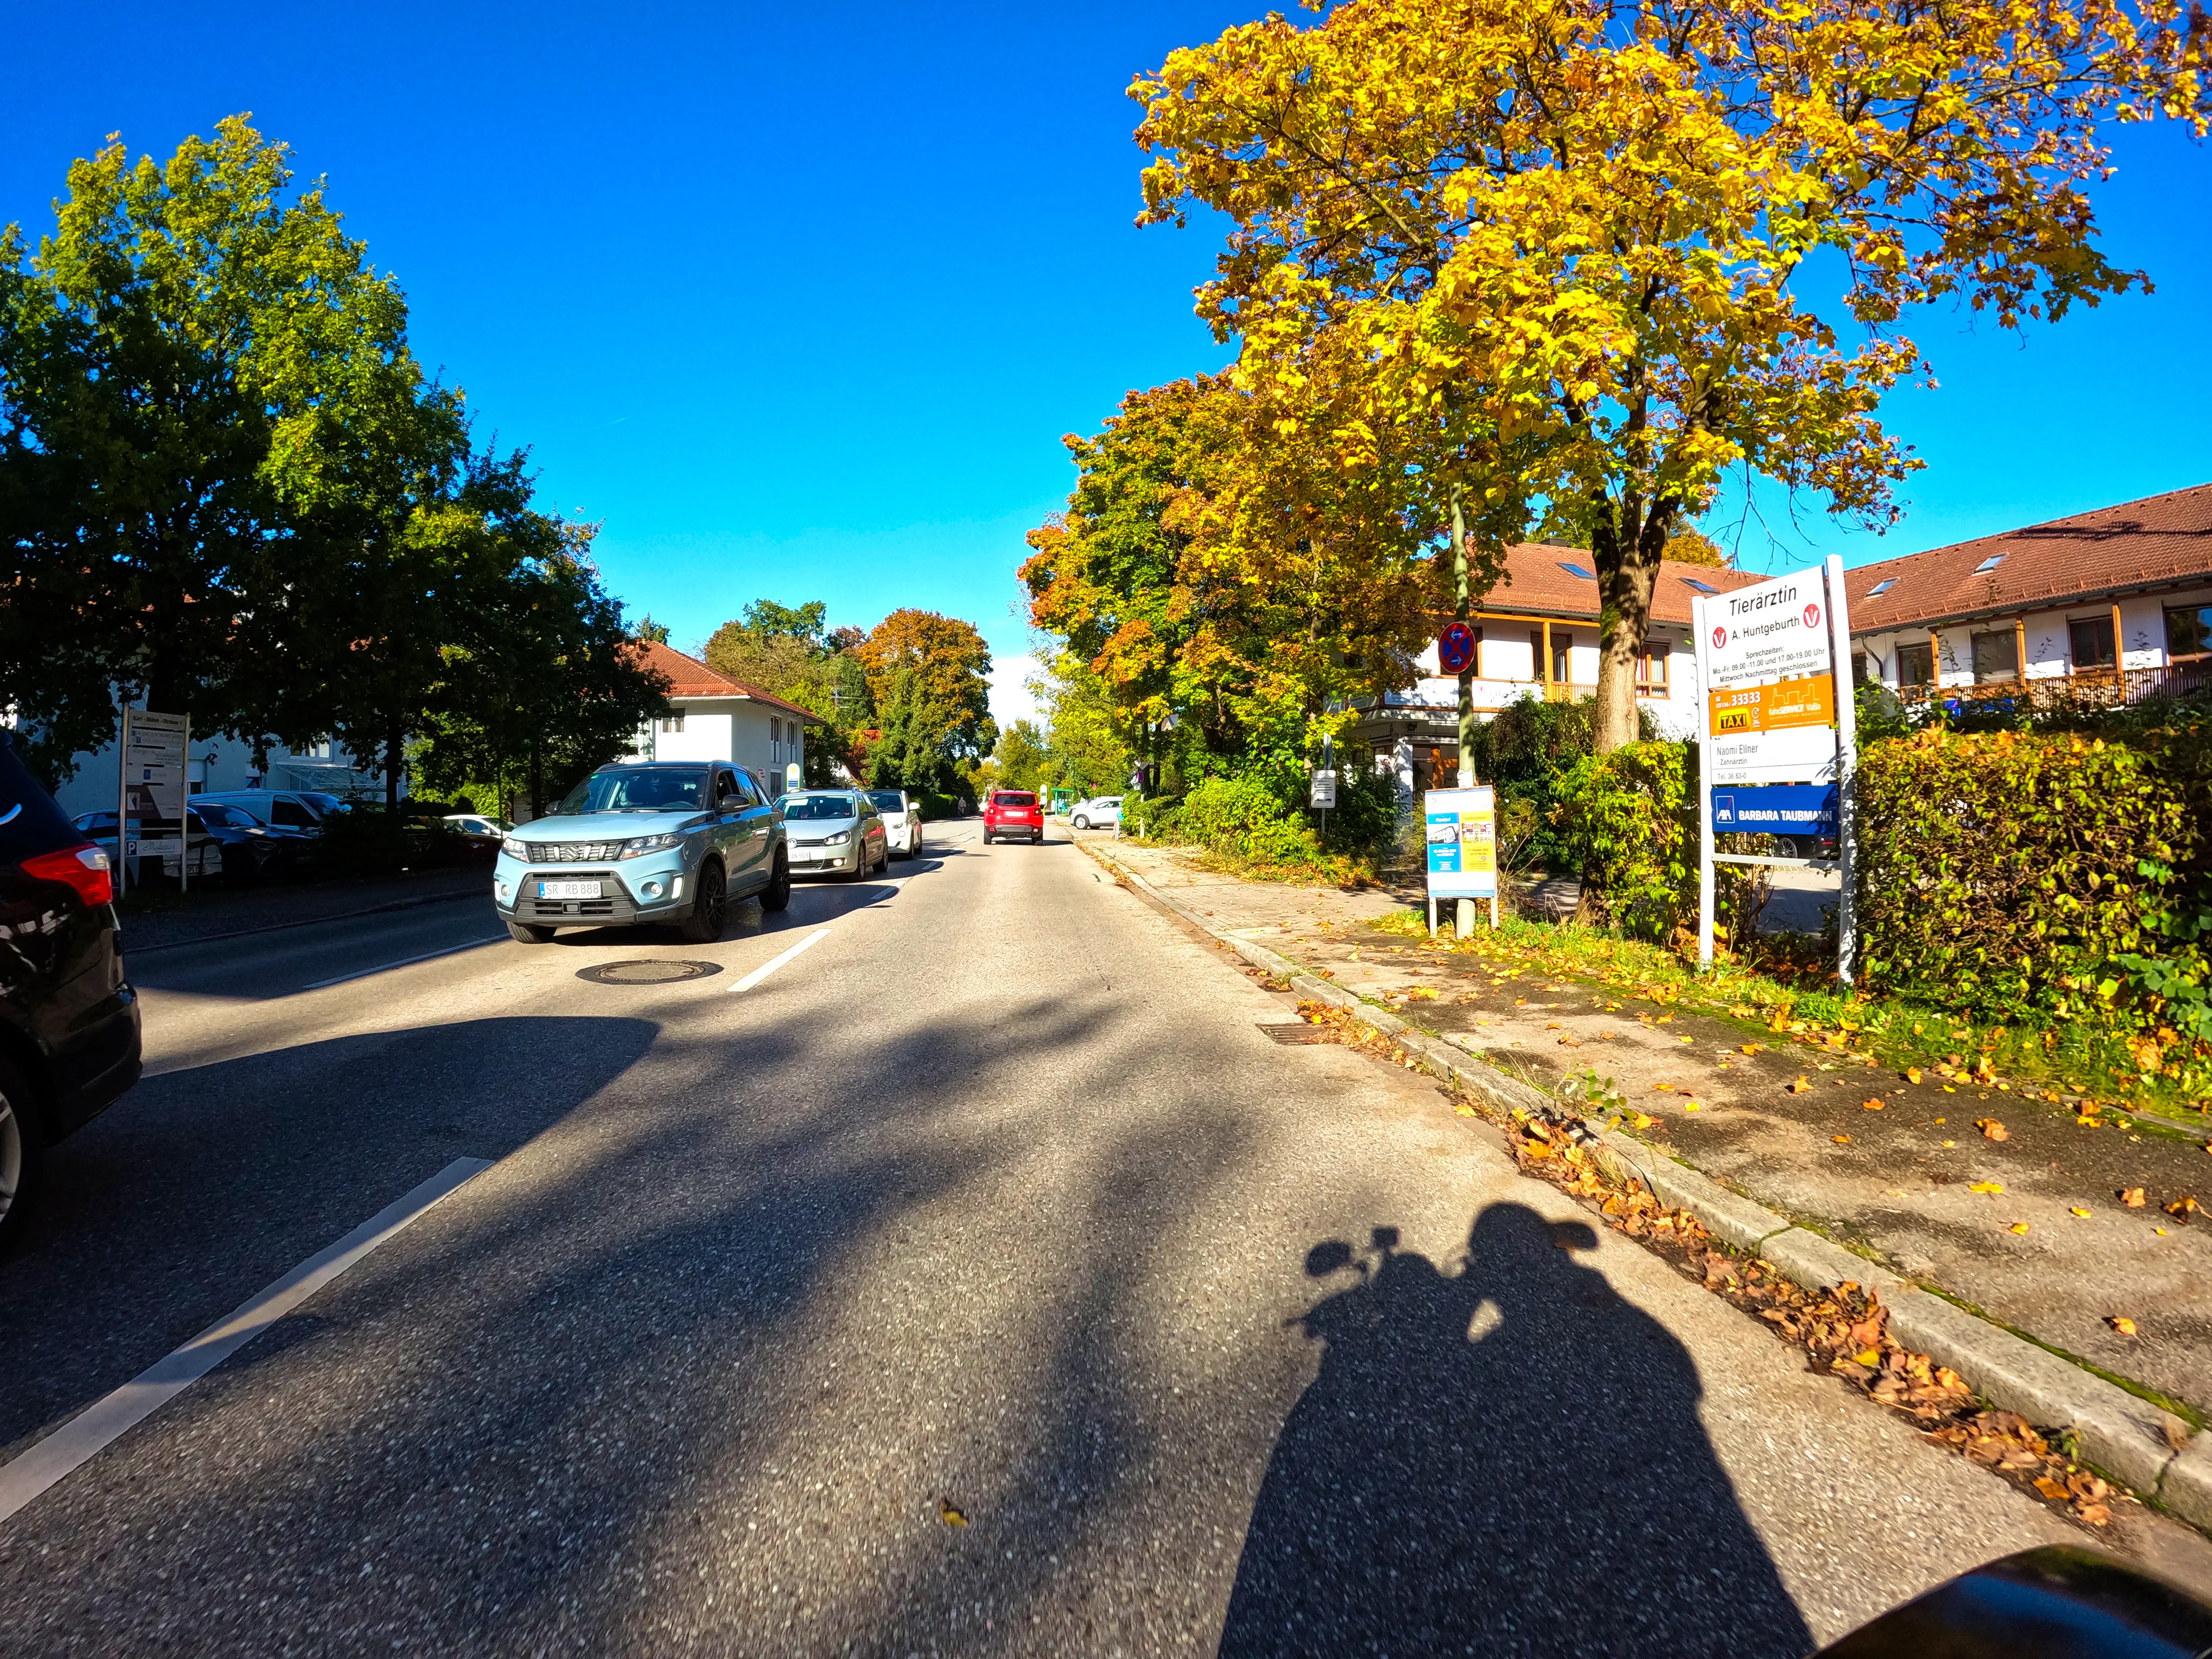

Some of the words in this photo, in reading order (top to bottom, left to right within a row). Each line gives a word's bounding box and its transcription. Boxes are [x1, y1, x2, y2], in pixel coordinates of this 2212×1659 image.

[1729, 585, 1797, 616] Tierärztin
[1732, 630, 1740, 640] A.
[1743, 616, 1800, 637] Huntgeburth
[1746, 646, 1785, 658] Sprechzeiten:
[1719, 674, 1743, 683] Mittwoch
[1745, 668, 1777, 678] Nachmittag
[1779, 660, 1818, 673] geschlossen
[1732, 663, 1746, 671] 09.00
[1731, 691, 1761, 706] 33333
[1721, 714, 1746, 728] TAXI
[1717, 746, 1737, 756] Naomi
[1739, 745, 1758, 754] Ellner
[1717, 810, 1732, 820] AXA
[1739, 810, 1779, 821] BARBARA
[1781, 810, 1832, 821] TAUBMANN
[129, 842, 135, 854] P
[546, 885, 558, 894] SR
[566, 884, 578, 894] RB
[581, 884, 598, 894] 888
